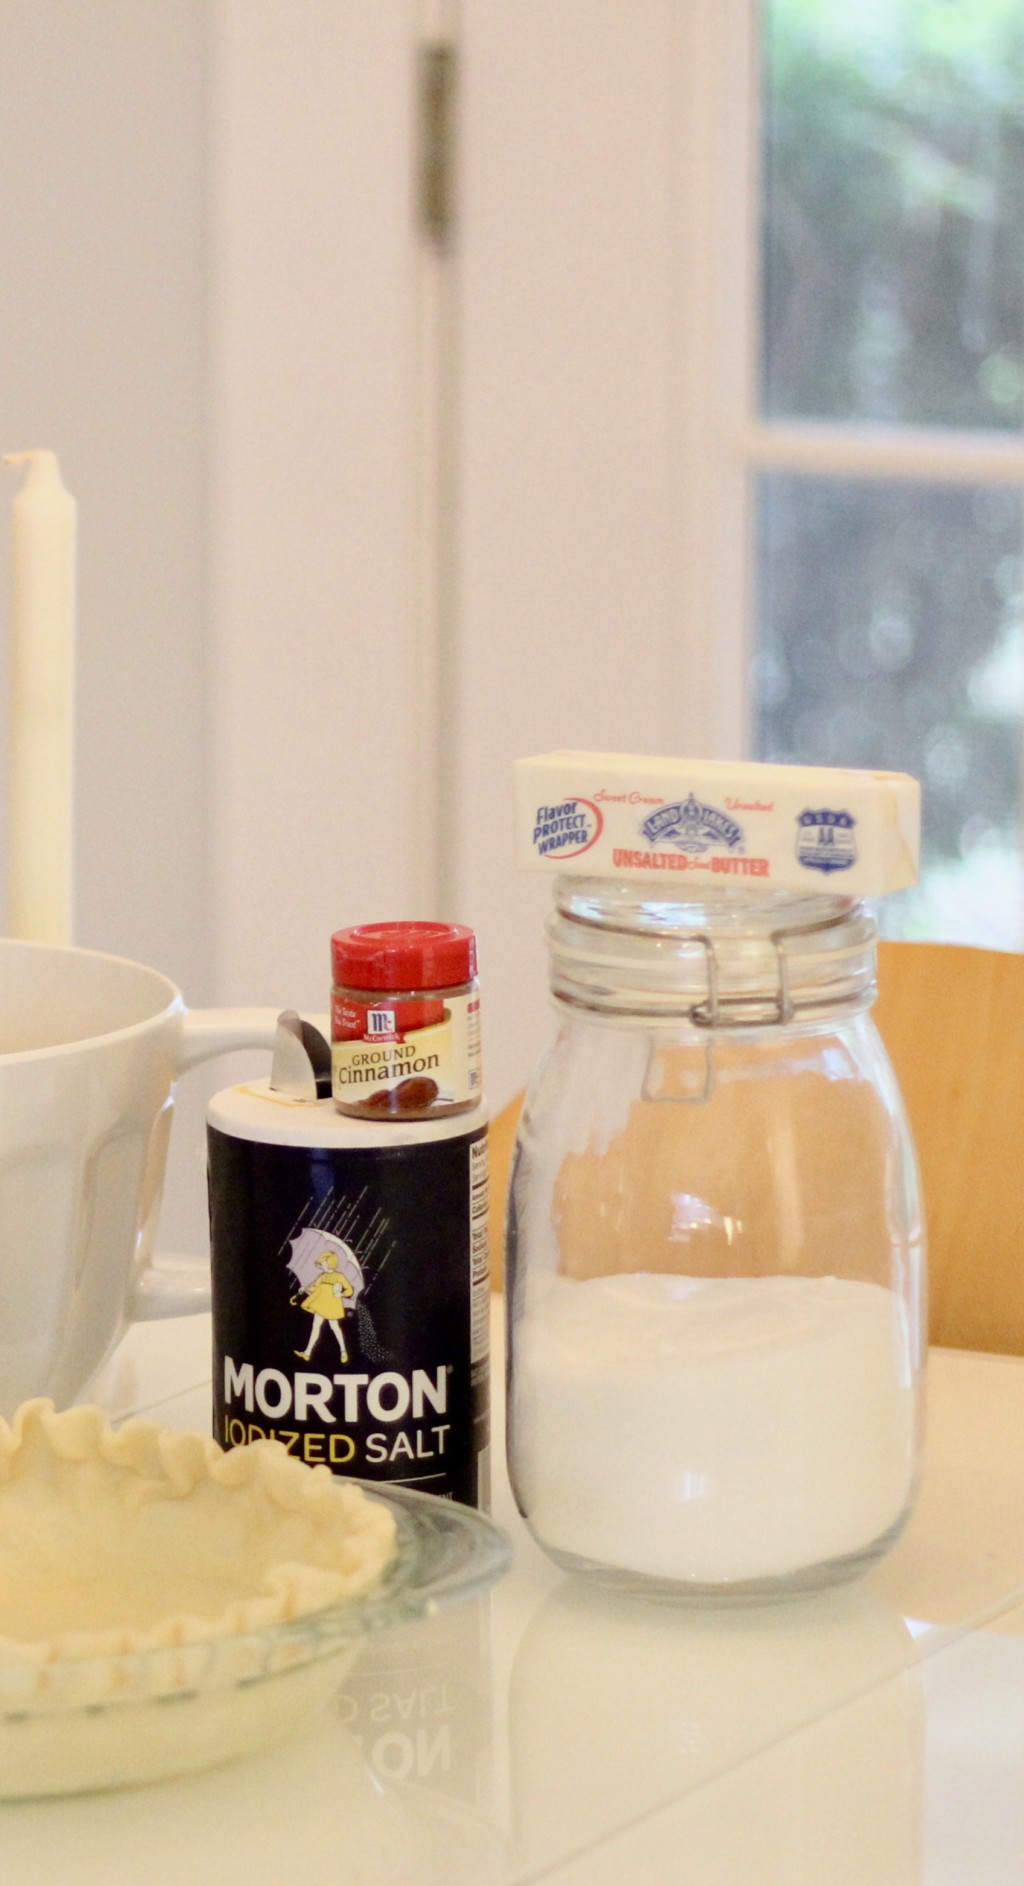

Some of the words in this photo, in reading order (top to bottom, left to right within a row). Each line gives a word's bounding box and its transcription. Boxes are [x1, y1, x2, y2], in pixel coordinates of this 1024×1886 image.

[536, 802, 578, 825] Flavor
[645, 807, 680, 834] LAND
[533, 814, 586, 844] PROTECT
[538, 829, 588, 856] WRAPPER
[612, 848, 688, 871] UNSALTED
[711, 857, 770, 877] BUTTER
[339, 1053, 440, 1085] Cinnamon
[351, 1045, 416, 1066] GROUND
[224, 1355, 448, 1423] MORTON
[365, 1425, 451, 1463] SALT
